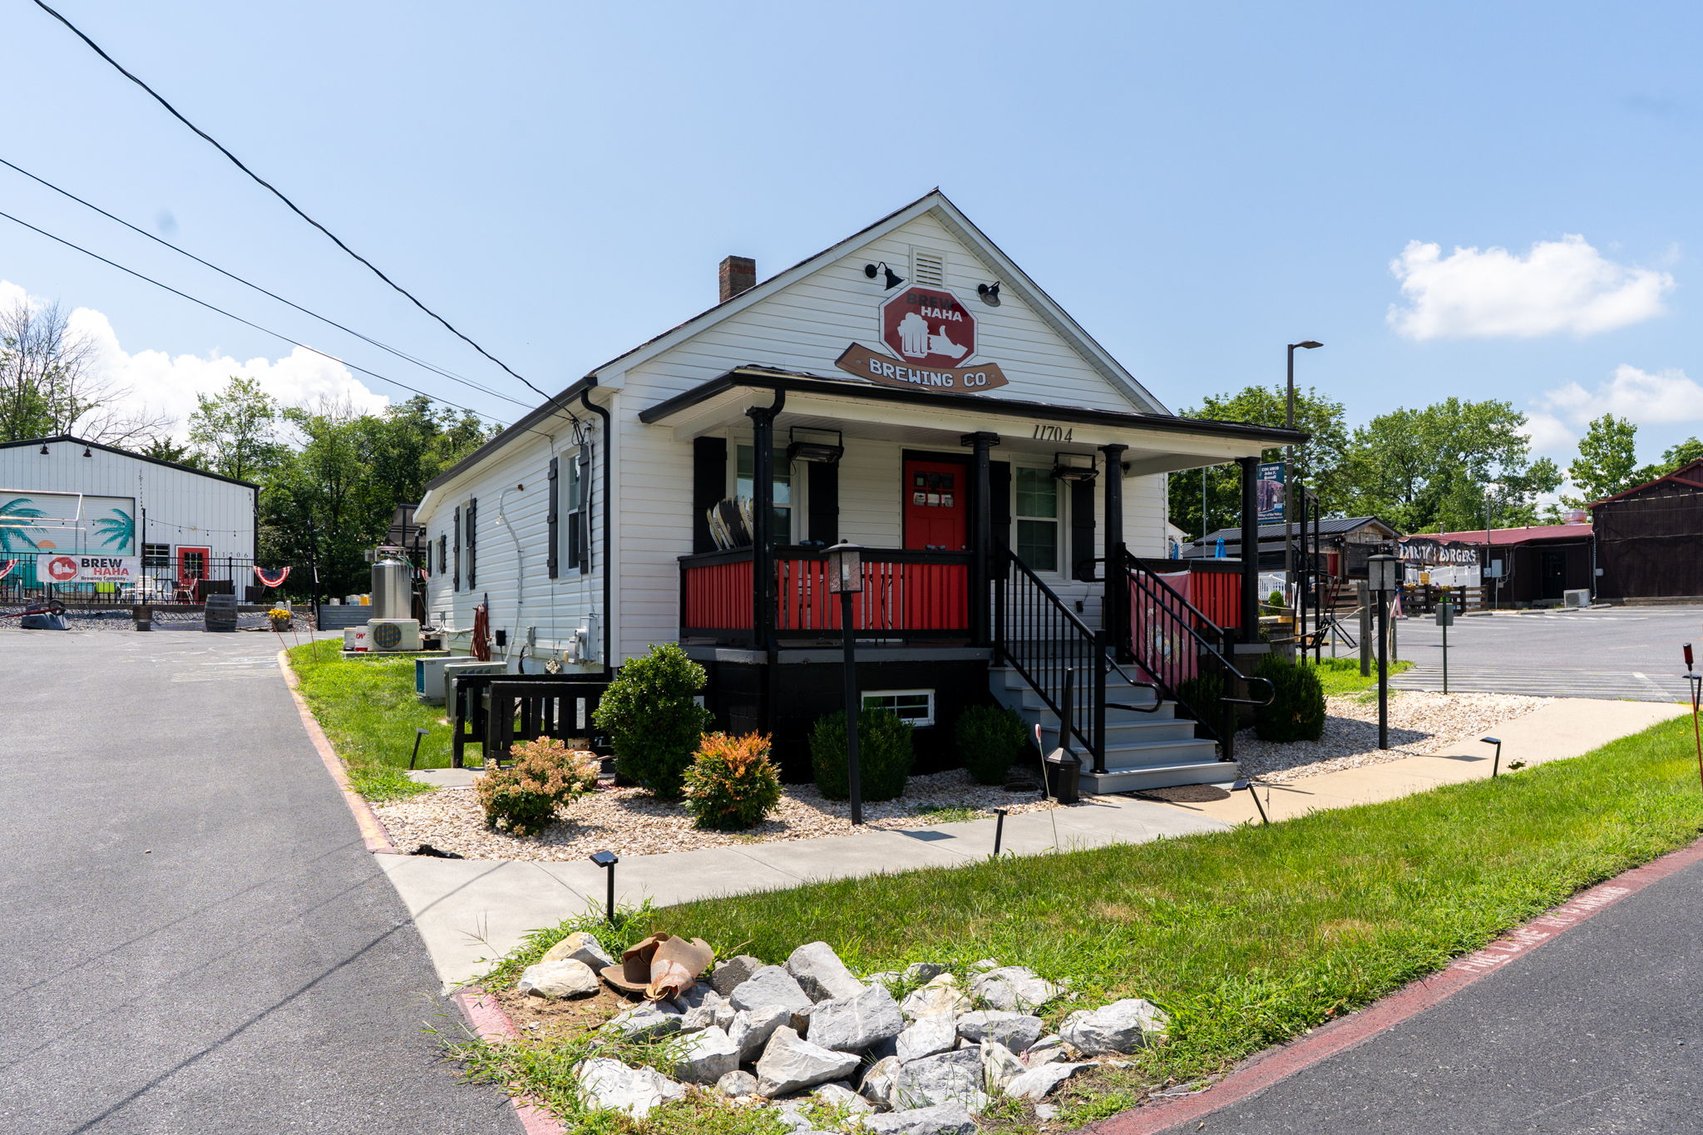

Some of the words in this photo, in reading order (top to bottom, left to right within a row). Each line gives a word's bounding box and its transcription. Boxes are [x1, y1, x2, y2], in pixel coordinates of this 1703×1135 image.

[907, 293, 953, 309] BREW
[920, 306, 963, 322] HAHA
[869, 357, 954, 388] BREWING
[1033, 424, 1072, 443] 11704
[81, 558, 122, 568] BREW
[93, 567, 130, 576] HAHA
